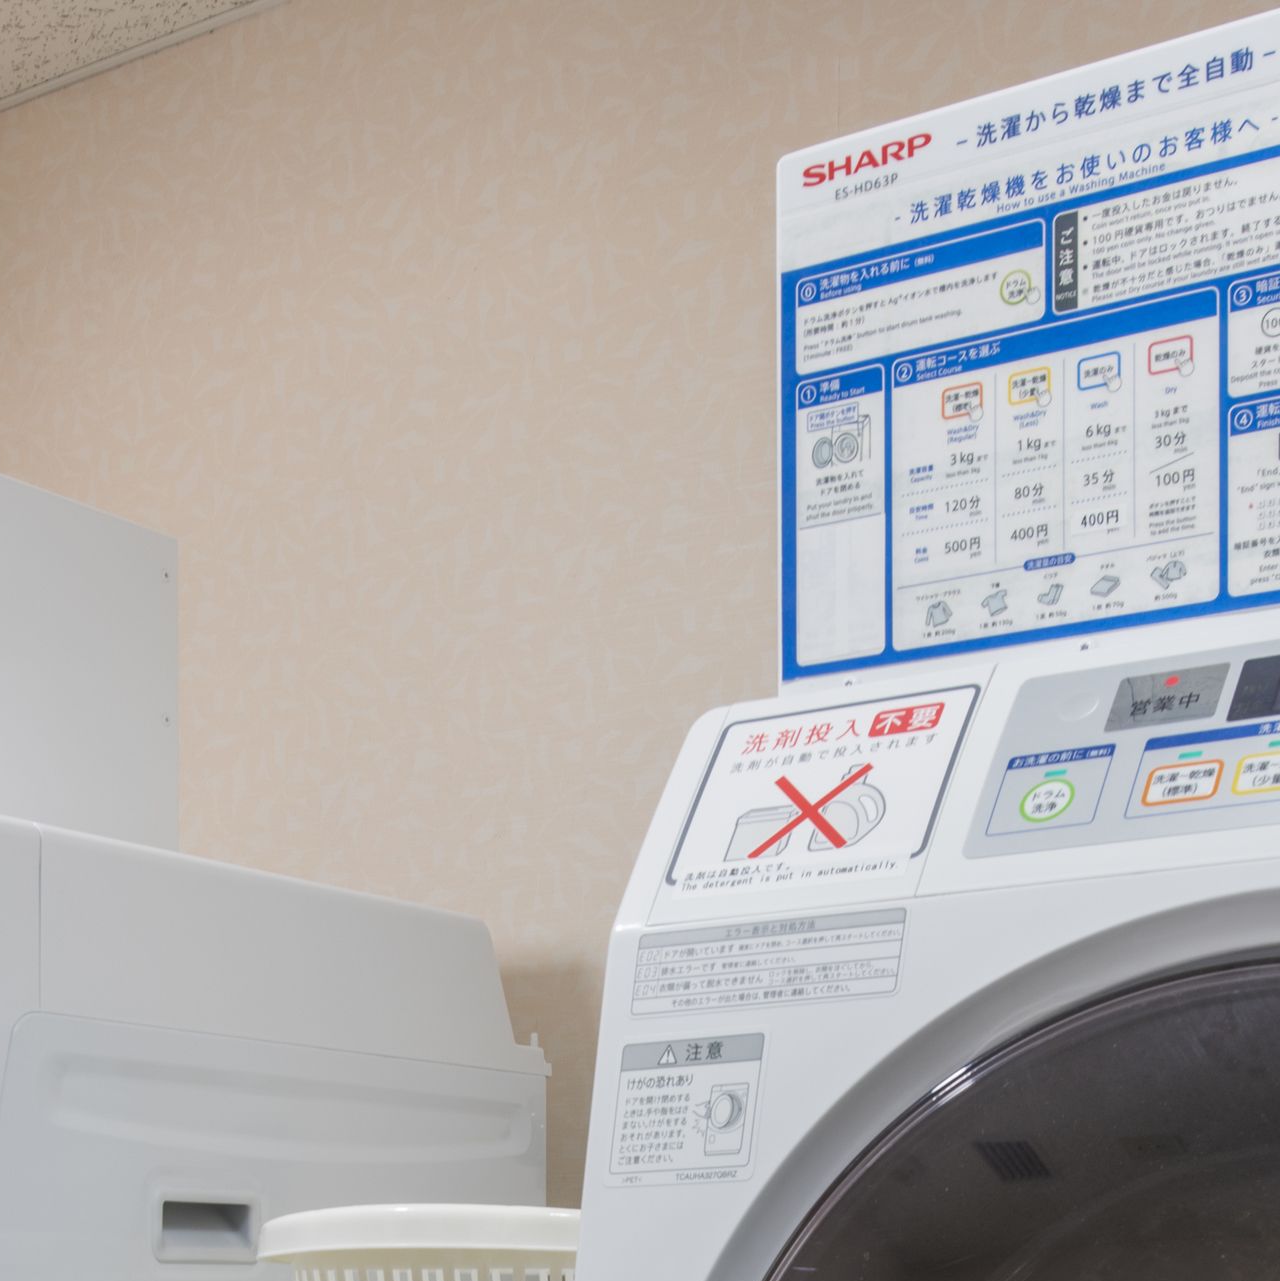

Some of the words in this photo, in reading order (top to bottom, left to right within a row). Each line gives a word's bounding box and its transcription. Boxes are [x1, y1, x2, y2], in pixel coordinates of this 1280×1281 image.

[803, 133, 932, 187] SHARP
[835, 173, 898, 199] ES-HD63P
[997, 203, 1020, 213] How
[1024, 198, 1034, 206] to
[1037, 191, 1055, 202] use
[1060, 189, 1066, 197] a
[1069, 174, 1115, 195] Washing
[1118, 162, 1166, 183] Machine
[1059, 228, 1076, 289] ご注意
[821, 287, 842, 299] Before
[843, 284, 862, 294] using
[1055, 291, 1077, 301] NOTICE
[916, 343, 1001, 372] 運転コースを選ぶ
[1154, 349, 1186, 363] 乾燥のみ
[916, 369, 937, 381] Select
[938, 365, 963, 377] Course
[1230, 371, 1258, 384] Deposit
[1259, 368, 1272, 376] the
[820, 380, 840, 392] 準備
[820, 392, 841, 402] Ready
[842, 389, 849, 397] to
[849, 386, 865, 396] Start
[1257, 418, 1280, 428] Finish
[1130, 692, 1201, 717] 営業中
[741, 719, 861, 755] 洗剤投入
[874, 706, 940, 735] 不要
[730, 732, 940, 775] 洗剤が自動で投入されます
[1012, 750, 1084, 768] お洗濯の前に
[1031, 789, 1065, 801] ドラム
[1031, 802, 1057, 814] 洗浄
[681, 881, 700, 892] The
[703, 876, 756, 891] detergent
[760, 874, 772, 885] is
[775, 871, 793, 885] put
[801, 869, 813, 878] in
[817, 859, 899, 879] automatically.
[683, 862, 791, 882] 洗剤は自動投入です。
[724, 919, 817, 938] エラー表示と対処方法
[684, 1040, 724, 1062] 注意
[626, 1074, 695, 1091] けがの恐れあり
[625, 1093, 691, 1106] ドアを開け閉めする
[619, 1140, 684, 1154] とくにお子さまには
